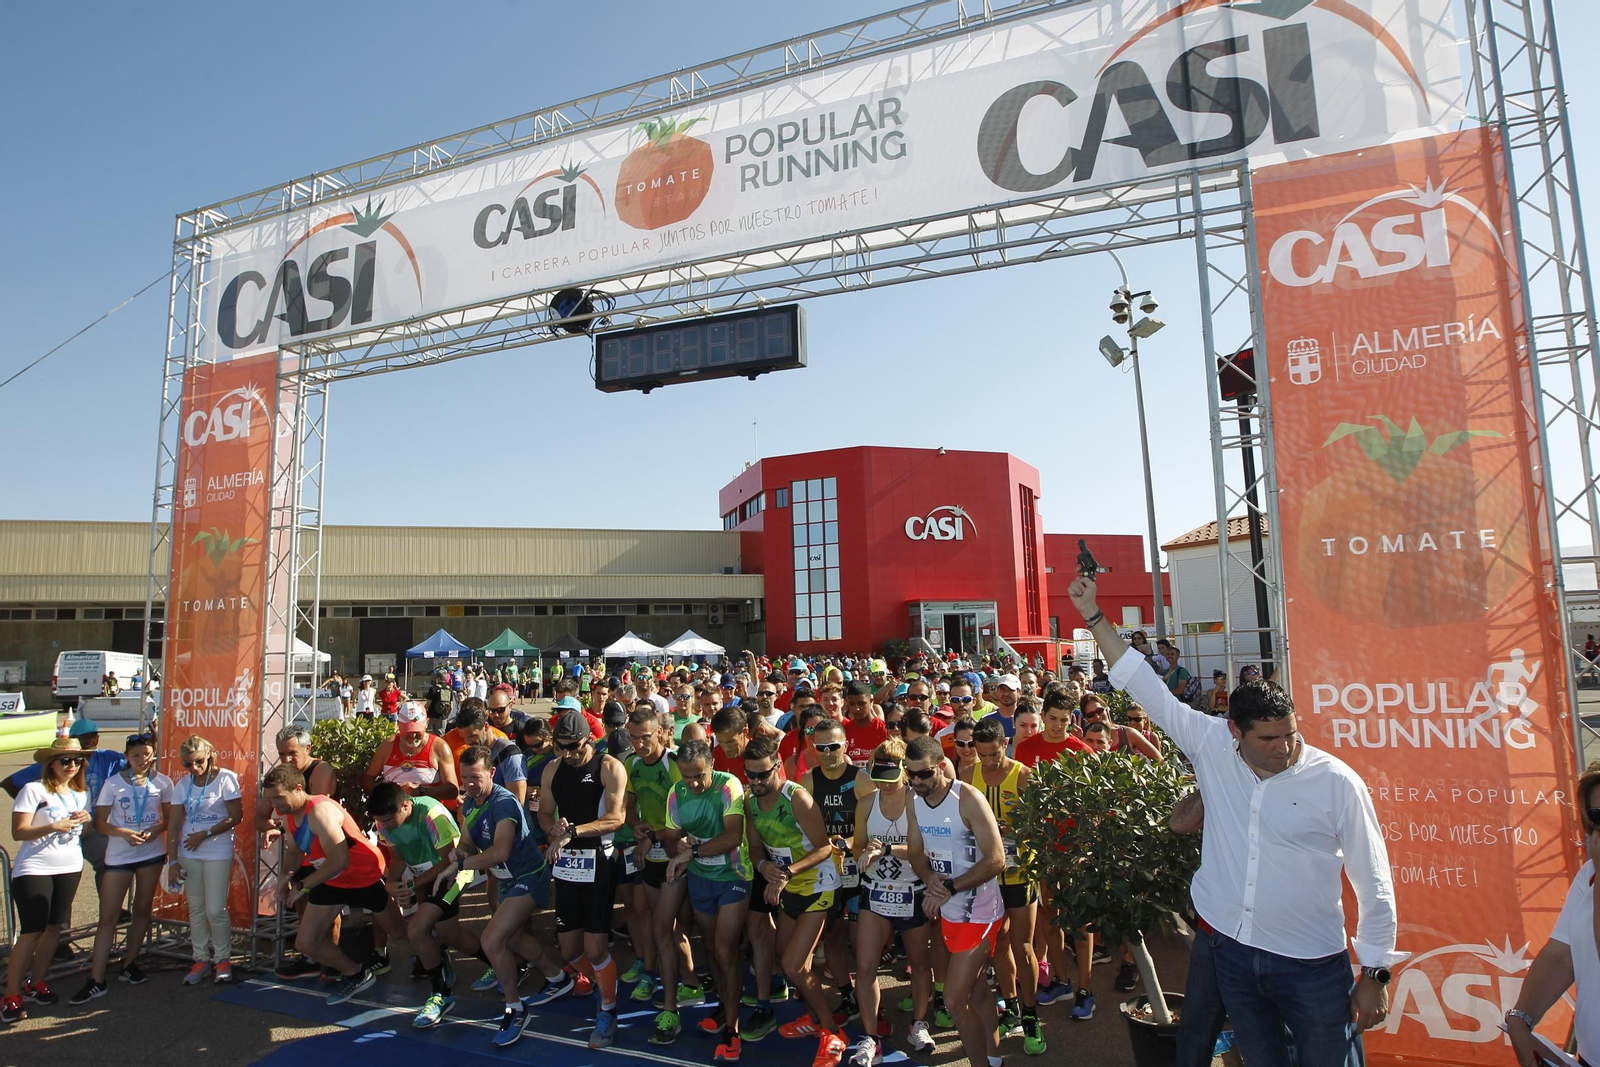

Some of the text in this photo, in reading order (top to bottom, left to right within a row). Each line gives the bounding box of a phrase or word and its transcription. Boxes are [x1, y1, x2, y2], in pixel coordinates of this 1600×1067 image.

[977, 22, 1319, 192] CASI
[725, 97, 903, 164] POPULAR
[740, 130, 907, 192] RUNNING
[625, 168, 700, 195] TOMATE
[473, 183, 577, 249] CASI
[502, 256, 571, 279] CARRERA
[579, 237, 651, 263] POPULAR
[658, 226, 706, 253] JUNTOS
[710, 218, 734, 237] POR
[738, 204, 801, 233] NUESTRO
[1269, 207, 1450, 286] CASI
[217, 240, 376, 349] CASI
[1351, 314, 1501, 356] ALMERÍA
[1352, 354, 1427, 375] CIUDAD
[184, 402, 253, 446] CASI
[207, 467, 264, 490] ALMERÍA
[206, 490, 235, 502] CIUDAD
[905, 516, 963, 540] CASI
[1321, 529, 1496, 556] TOMATE
[183, 596, 248, 612] TOMATE
[170, 687, 246, 707] POPULAR
[1311, 682, 1527, 714] POPULAR
[176, 709, 248, 728] RUNNING
[1332, 718, 1537, 749] RUNNING
[824, 794, 843, 806] ALEX
[1451, 788, 1566, 806] POPULAR
[868, 833, 907, 843] HERBALIF
[920, 826, 951, 835] ECATHLON
[1409, 822, 1443, 842] POR
[1449, 824, 1538, 846] NUESTRO
[565, 858, 585, 869] 341
[930, 860, 945, 873] 03
[879, 891, 904, 903] 488
[1352, 964, 1525, 1046] ASI
